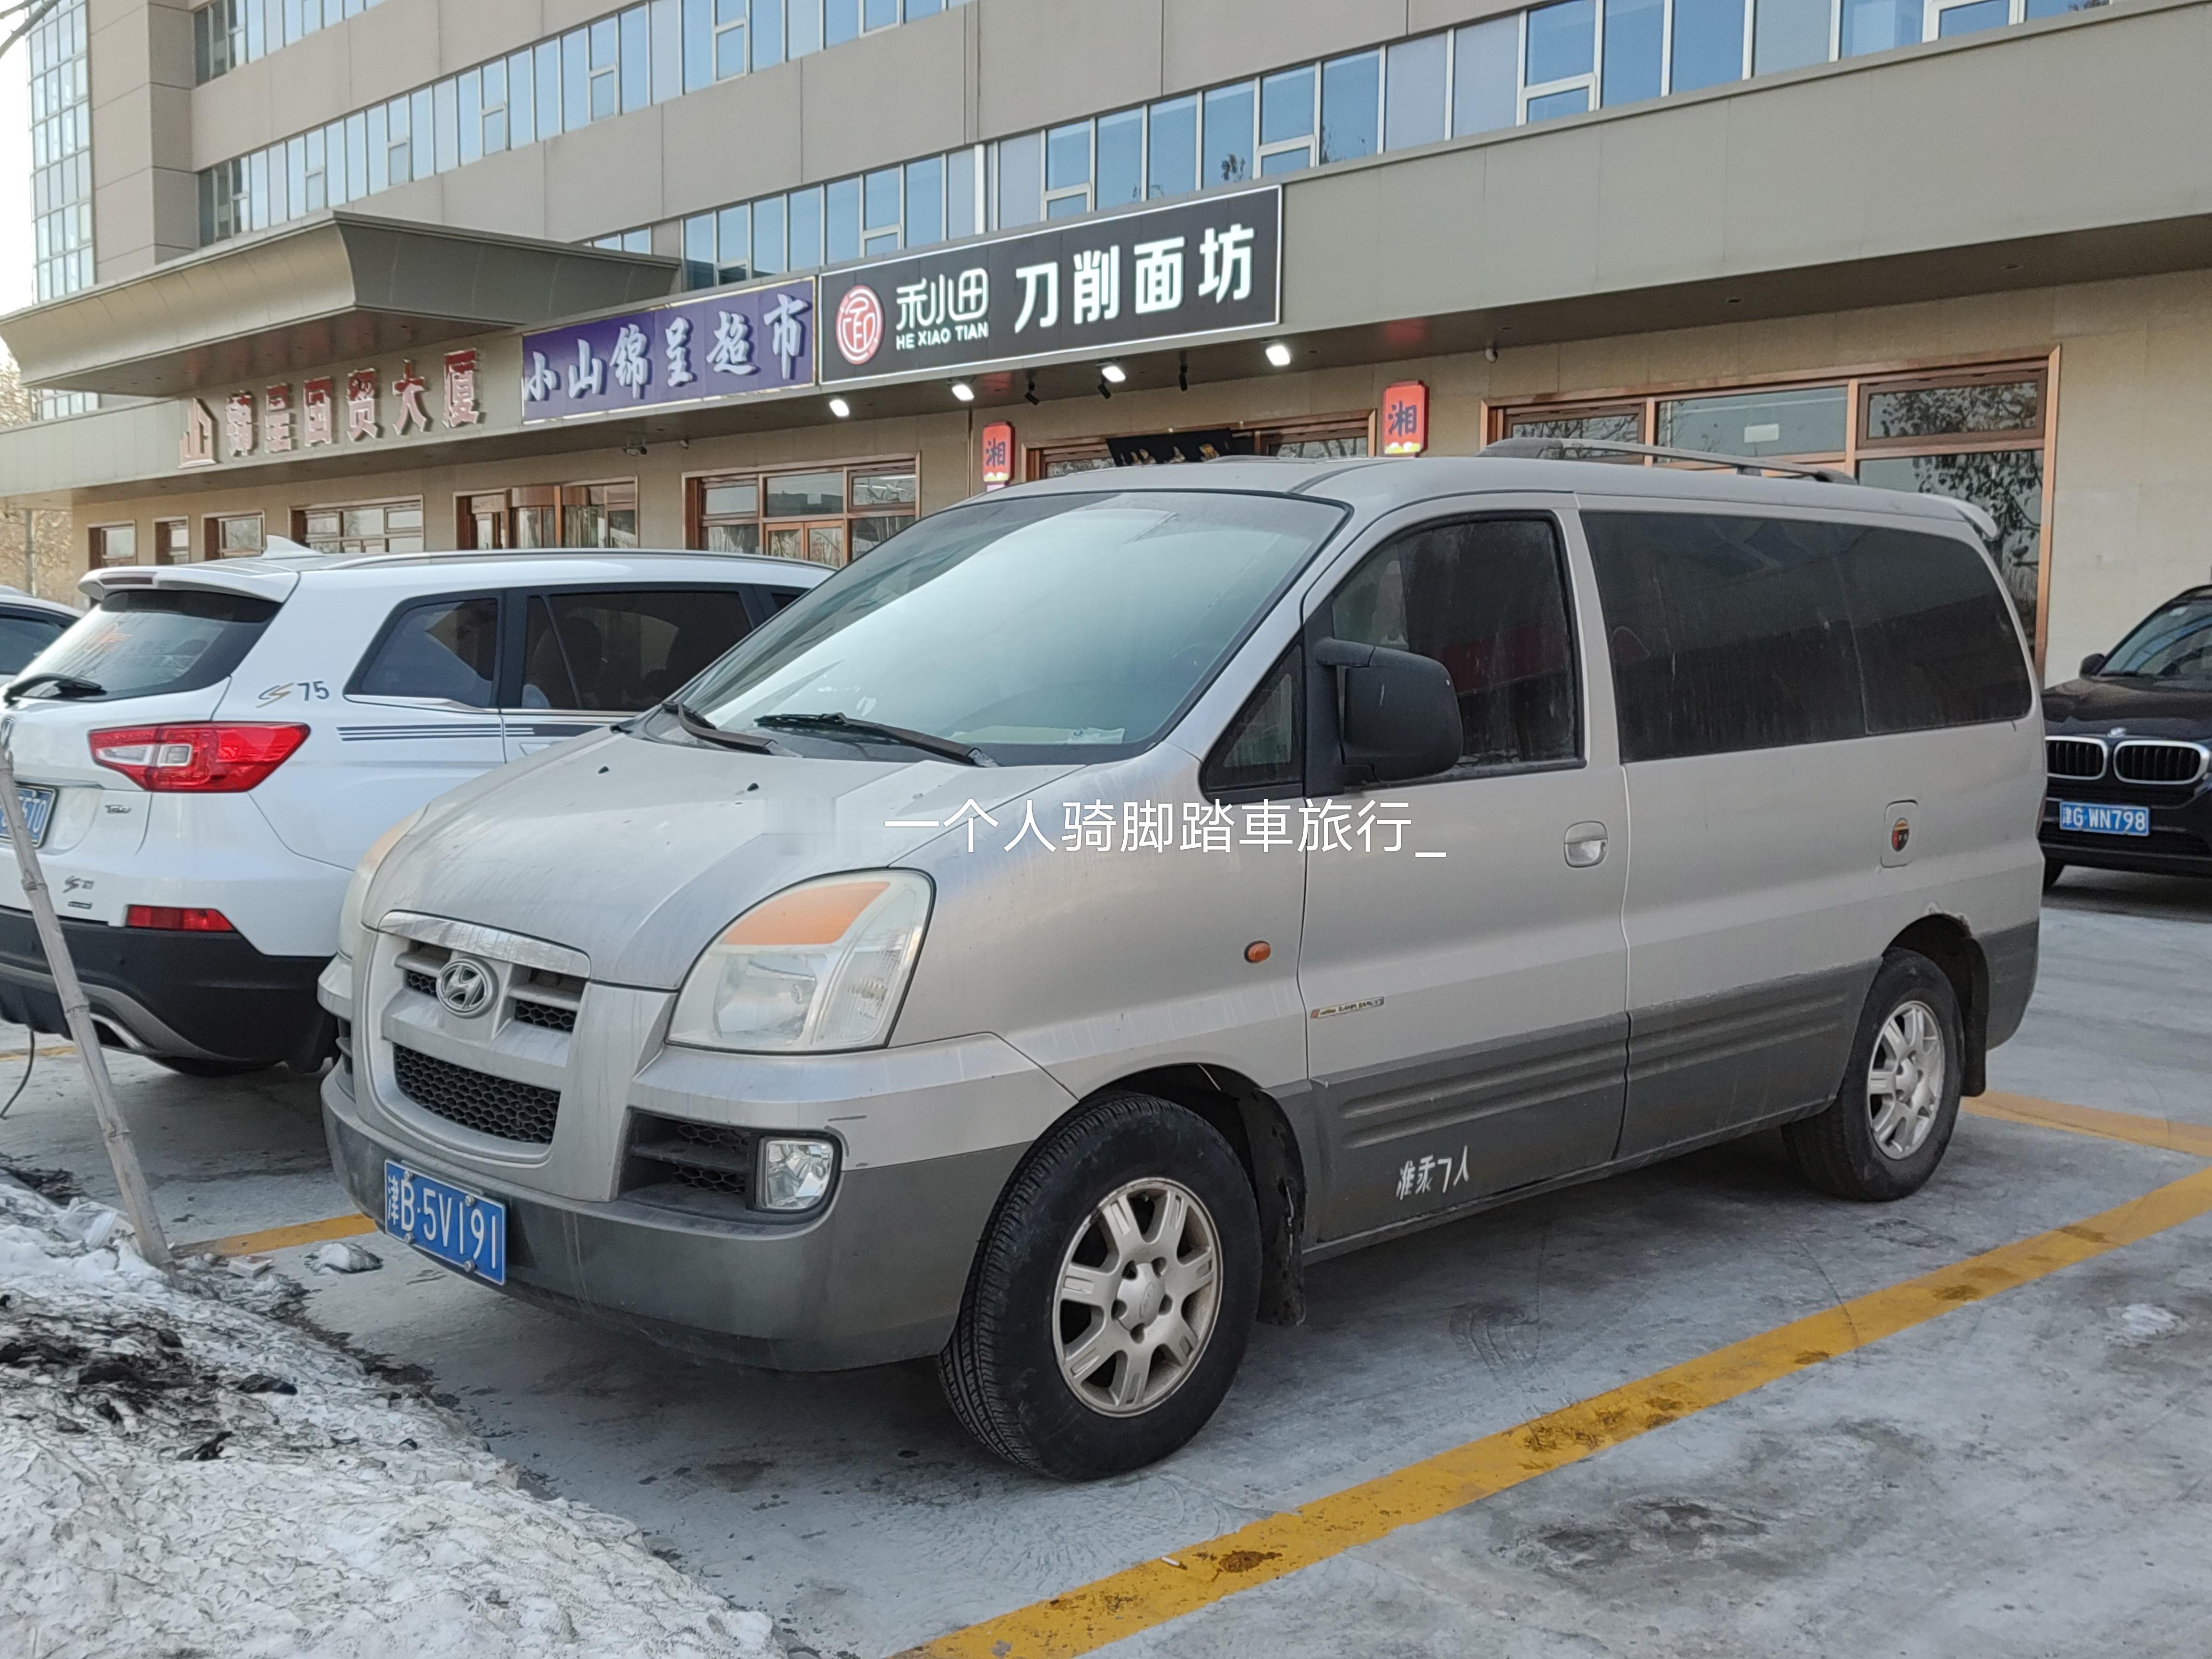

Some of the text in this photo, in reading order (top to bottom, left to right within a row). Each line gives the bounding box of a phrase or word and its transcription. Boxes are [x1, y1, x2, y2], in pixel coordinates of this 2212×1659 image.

[1014, 223, 1254, 333] 刀削面坊
[896, 322, 989, 350] HE XIAO TIAN
[1387, 399, 1417, 438] 湘
[986, 436, 1006, 468] 湘
